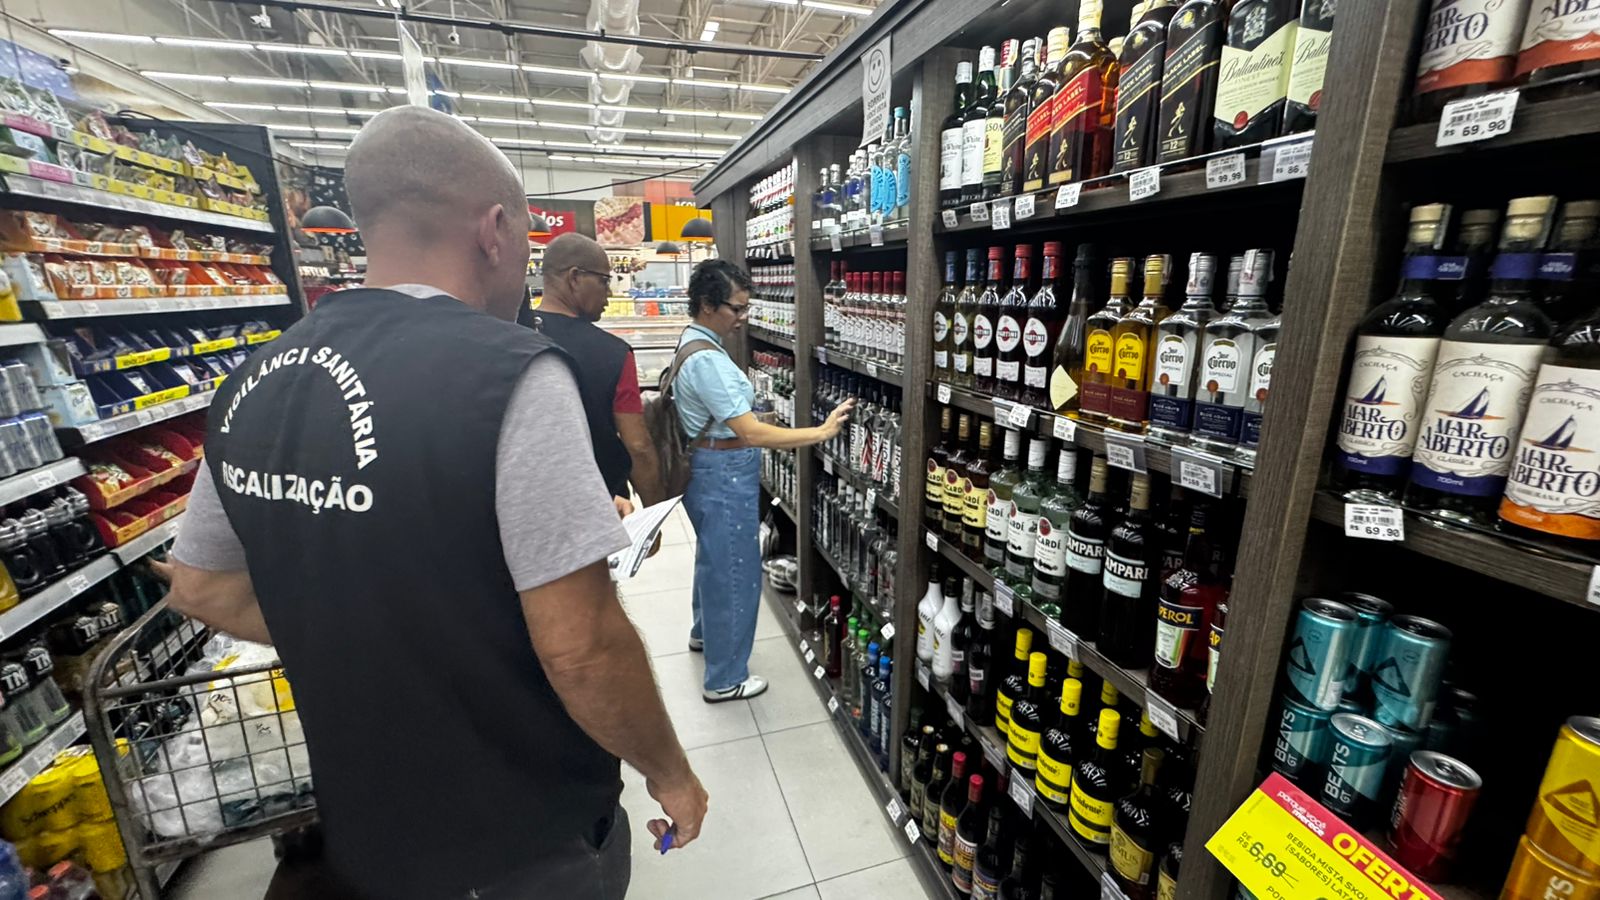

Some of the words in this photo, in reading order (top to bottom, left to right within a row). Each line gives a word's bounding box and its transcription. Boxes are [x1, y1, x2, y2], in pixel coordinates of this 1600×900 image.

[1220, 51, 1286, 84] Ballantine's
[1062, 84, 1087, 107] LABEL
[1207, 355, 1237, 370] Cuervo
[1452, 370, 1505, 383] CACHAÇA
[311, 346, 379, 470] SANITÁRIA
[1419, 426, 1510, 459] ABERTO
[1436, 417, 1493, 440] MAR
[1274, 709, 1296, 763] BEATS
[1324, 742, 1351, 799] BEATS
[1241, 831, 1252, 841] DE
[1291, 809, 1325, 838] merece
[1249, 841, 1288, 878] 6,69
[1286, 832, 1317, 860] BEBIDA
[1316, 857, 1345, 883] MISTA
